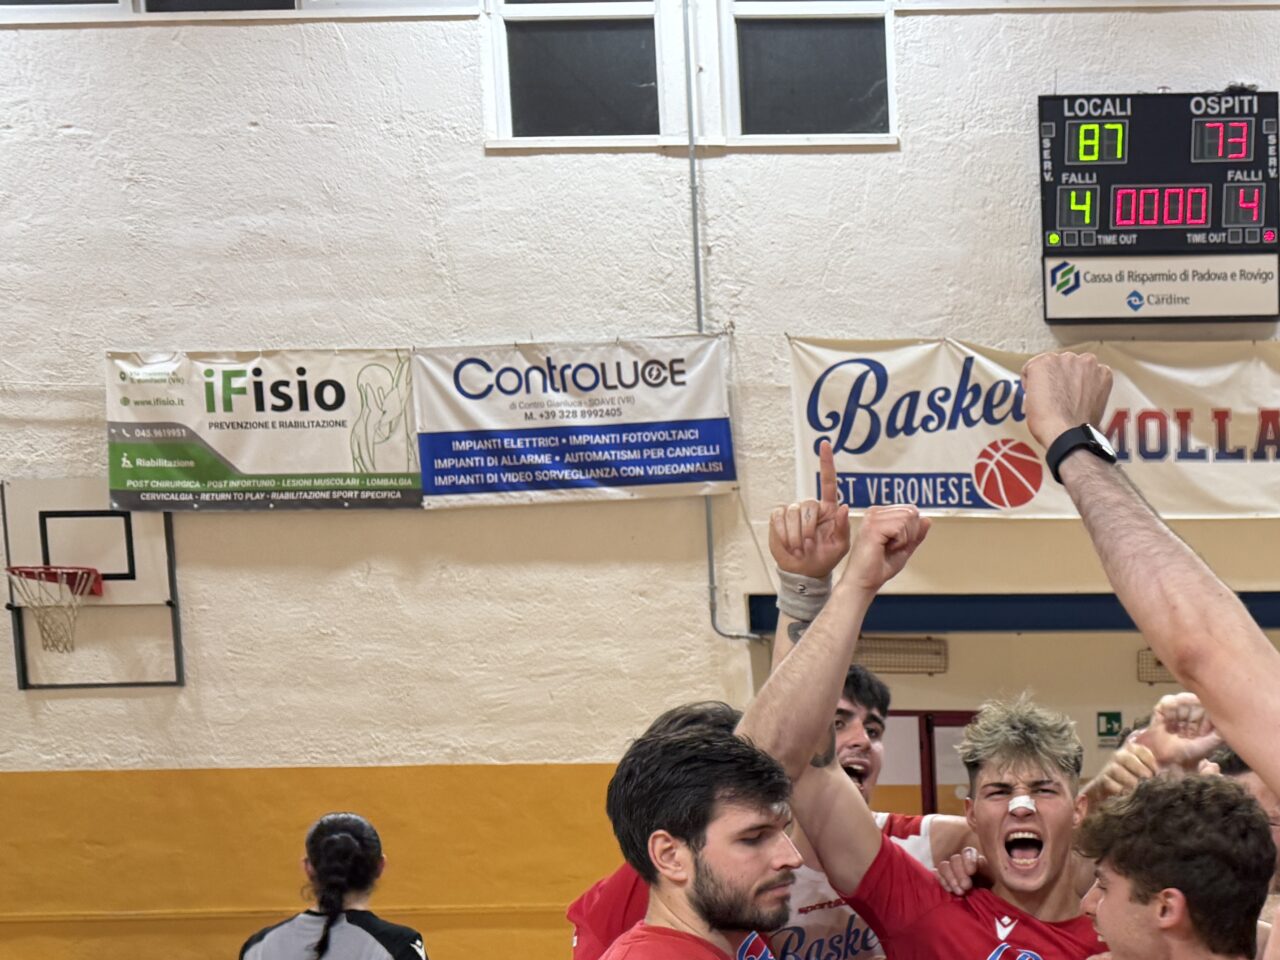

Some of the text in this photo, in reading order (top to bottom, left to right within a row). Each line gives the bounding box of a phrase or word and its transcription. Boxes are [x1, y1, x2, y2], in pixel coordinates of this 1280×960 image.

[1064, 98, 1131, 116] LOCALI
[1190, 96, 1258, 115] OSPITI
[1079, 123, 1123, 161] 87
[1205, 122, 1248, 159] 73
[1061, 173, 1097, 184] FALLI
[1227, 170, 1262, 181] FALLI
[1070, 191, 1091, 224] 4
[1116, 188, 1207, 225] 0000
[1239, 189, 1259, 221] 4
[1097, 234, 1138, 245] TIME OUT
[1187, 233, 1226, 243] TIME OUT
[1083, 268, 1274, 285] Cassa di Risparmio di Padova e Rovigo
[203, 366, 346, 413] iFisio
[524, 412, 536, 421] M.
[539, 410, 556, 419] +39
[559, 410, 578, 419] 328
[208, 420, 348, 430] PREVENZIONE E RIABILITAZIONE
[452, 429, 699, 451] IMPIANTI ELETTRICI IMPIANTI FOTOVOLTAICI
[136, 458, 195, 467] Riabilitazione
[434, 444, 720, 469] IMPIANTI DI ALLARME AUTOMATISMI PER CANCELLI
[434, 461, 723, 486] IMPIANTI DI VIDEO SORVEGLIANZA CON VIDEOANALISI
[127, 480, 149, 488] POST
[150, 480, 200, 488] CHIRURGICA
[229, 479, 275, 487] INFORTUNIO
[366, 478, 412, 486] LOMBALGIA
[866, 476, 972, 505] VERONESE
[140, 493, 193, 501] CERVICALGIA
[245, 492, 265, 500] PLAY
[271, 491, 331, 500] RIABILITAZIONE
[332, 491, 358, 499] SPORT
[360, 491, 402, 499] SPECIFICA
